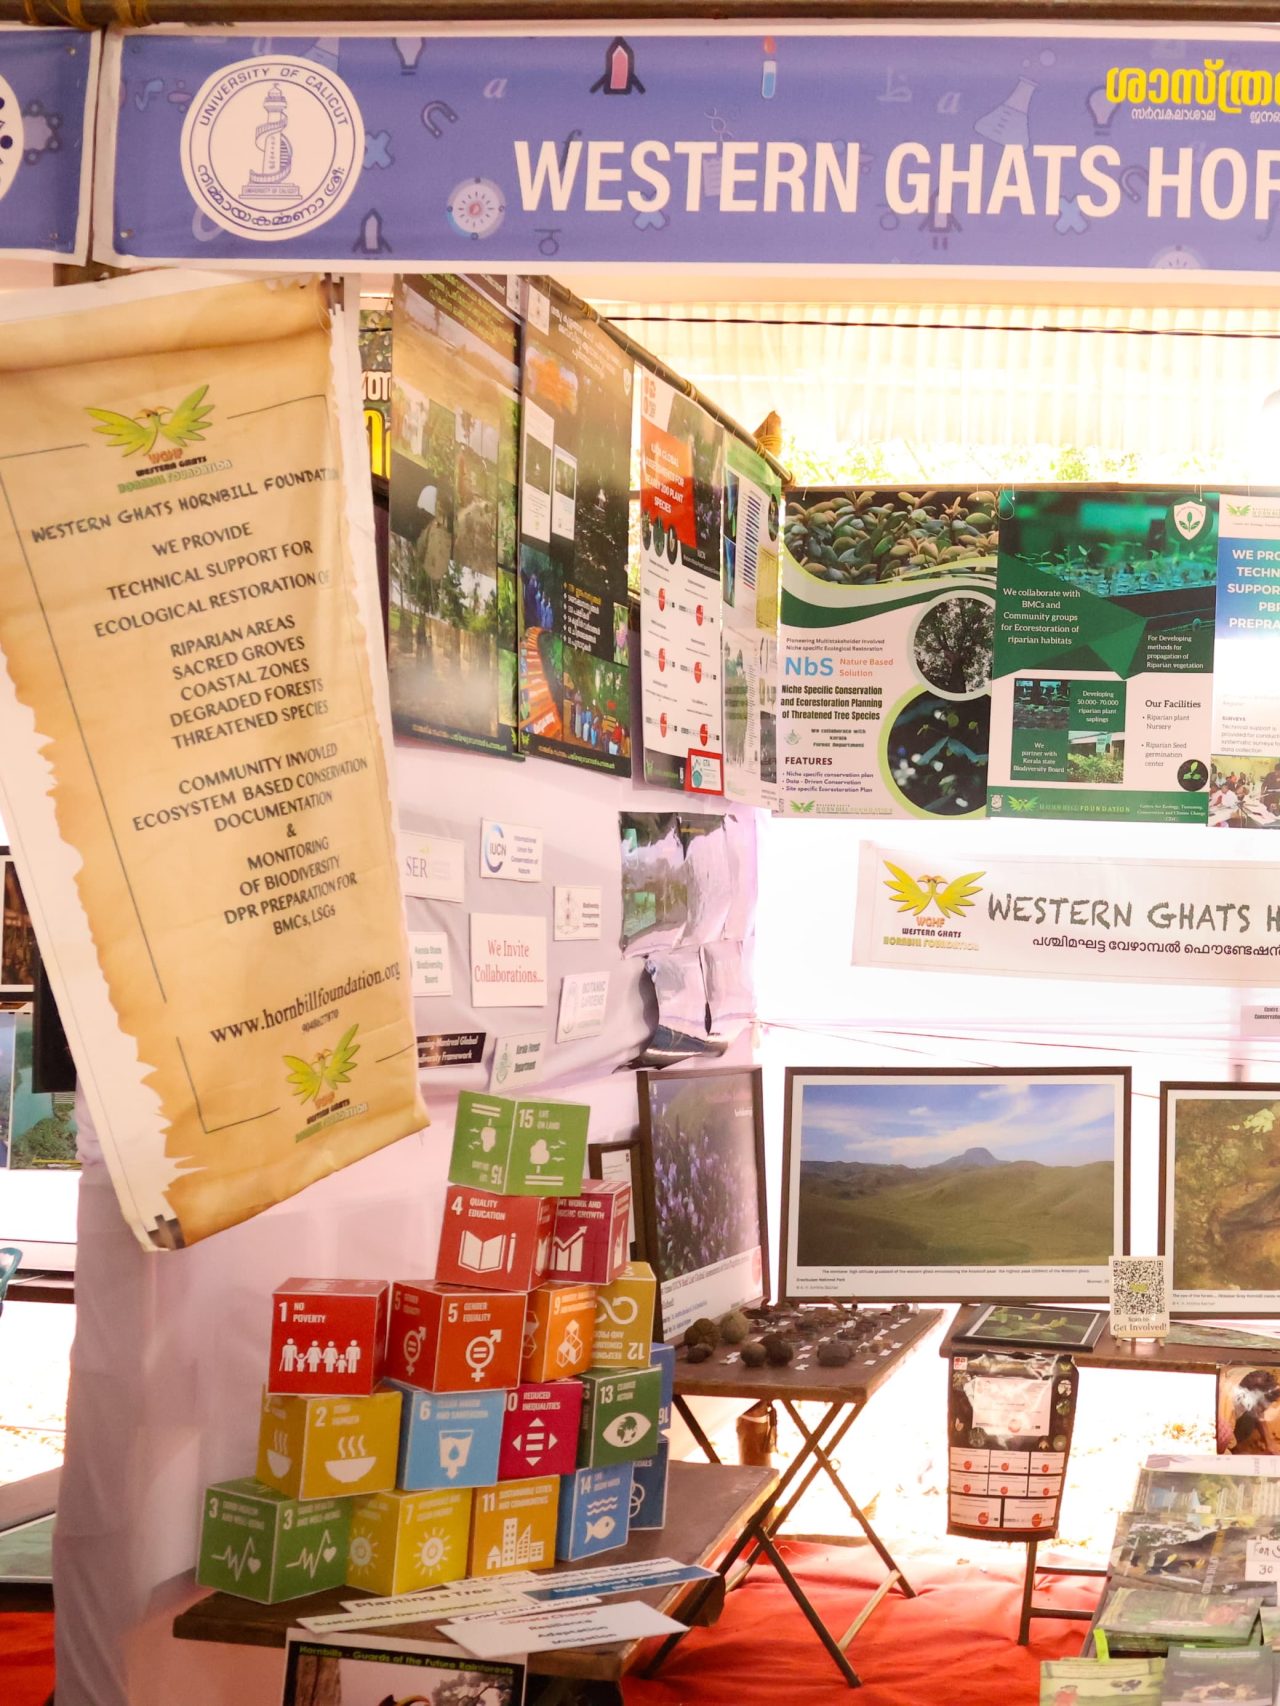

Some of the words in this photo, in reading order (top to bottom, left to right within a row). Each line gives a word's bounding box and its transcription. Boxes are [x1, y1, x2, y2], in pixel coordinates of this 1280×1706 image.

[199, 67, 270, 126] UNIVERSITY
[280, 68, 300, 78] OF
[305, 75, 348, 126] CALICUT
[513, 139, 860, 213] WESTERN
[884, 142, 1121, 218] GHATS
[32, 513, 111, 544] WESTERN
[117, 501, 173, 524] GHATS
[178, 481, 259, 512] HORNBILL
[152, 540, 178, 557] WE
[181, 521, 253, 551] PROVIDE
[1232, 549, 1255, 561] WE
[106, 566, 204, 601] TECHNICAL
[206, 547, 279, 580] SUPPORT
[282, 539, 314, 560] FOR
[1003, 587, 1016, 597] We
[1017, 588, 1061, 598] collaborate
[1062, 589, 1081, 599] with
[93, 599, 208, 638] ECOLOGICAL
[209, 571, 316, 611] RESTORATION
[1021, 600, 1044, 609] BMCs
[1046, 600, 1061, 610] and
[1001, 622, 1013, 632] for
[1014, 622, 1069, 633] Ecorestoration
[1070, 624, 1080, 633] of
[1003, 612, 1050, 623] Community
[1051, 614, 1079, 624] groups
[170, 627, 244, 659] RIPARIAN
[245, 613, 297, 640] AREAS
[1007, 635, 1039, 647] riparian
[1040, 636, 1073, 646] habitats
[1147, 634, 1157, 642] For
[1158, 634, 1192, 644] Developing
[1147, 643, 1172, 651] methods
[1173, 643, 1182, 651] for
[1147, 652, 1181, 661] propagation
[1182, 652, 1190, 660] of
[172, 653, 239, 681] SACRED
[241, 634, 306, 662] GROVES
[785, 656, 834, 676] NbS
[839, 658, 868, 666] Nature
[869, 658, 894, 666] Based
[1146, 661, 1172, 670] Riparian
[1172, 662, 1204, 671] vegetation
[179, 671, 255, 702] COASTAL
[257, 657, 311, 681] ZONES
[839, 669, 873, 677] Solution
[781, 684, 802, 694] Niche
[803, 685, 833, 695] Specific
[834, 685, 883, 695] Conservation
[170, 693, 262, 728] DEGRADED
[264, 677, 325, 703] FORESTS
[780, 698, 795, 706] and
[796, 698, 850, 707] Ecorestoration
[851, 698, 883, 709] Planning
[1145, 699, 1162, 708] Our
[1163, 699, 1202, 709] Facilities
[171, 712, 279, 749] THREATENED
[280, 699, 330, 724] SPECIES
[781, 710, 790, 719] of
[791, 710, 832, 719] Threatened
[834, 711, 850, 720] Tree
[851, 711, 880, 721] Species
[178, 757, 283, 796] COMMUNITY
[285, 742, 339, 769] INVOVLED
[784, 756, 833, 765] FEATURES
[132, 791, 237, 832] ECOSYSTEM
[243, 776, 294, 801] BASED
[295, 757, 369, 789] CONSERVATION
[213, 790, 333, 832] DOCUMENTATION
[285, 823, 297, 838] &
[246, 836, 330, 871] MONITORING
[239, 879, 260, 896] OF
[263, 855, 341, 891] BIODIVERSITY
[405, 855, 428, 879] SER
[223, 900, 259, 925] DPR
[260, 879, 337, 914] PREPARATION
[336, 871, 359, 894] FOR
[311, 904, 336, 925] LSGs
[915, 914, 945, 928] WGHF
[987, 892, 1133, 930] WESTERN
[1147, 901, 1251, 933] GHATS
[901, 927, 935, 936] WESTERN
[937, 930, 962, 939] GHATS
[487, 939, 501, 957] We
[503, 940, 530, 957] Invite
[209, 959, 401, 1045] www.hornbillfoundation.org
[518, 1108, 535, 1128] 15
[451, 1196, 463, 1216] 4
[469, 1197, 498, 1209] QUALITY
[468, 1209, 506, 1221] EDUCATION
[279, 1301, 288, 1323] 1
[294, 1301, 306, 1311] NO
[293, 1313, 327, 1324] POVERTY
[447, 1302, 458, 1323] 5
[462, 1311, 492, 1323] EQUALITY
[1112, 1323, 1128, 1332] Get
[1129, 1323, 1167, 1332] Involved!
[522, 1391, 551, 1401] REDUCED
[600, 1385, 614, 1405] 13
[315, 1405, 327, 1428] 2
[419, 1399, 431, 1421] 6
[522, 1401, 561, 1412] INEQUALITIES
[207, 1496, 219, 1518] 3
[481, 1492, 496, 1513] 11
[282, 1508, 294, 1530] 3
